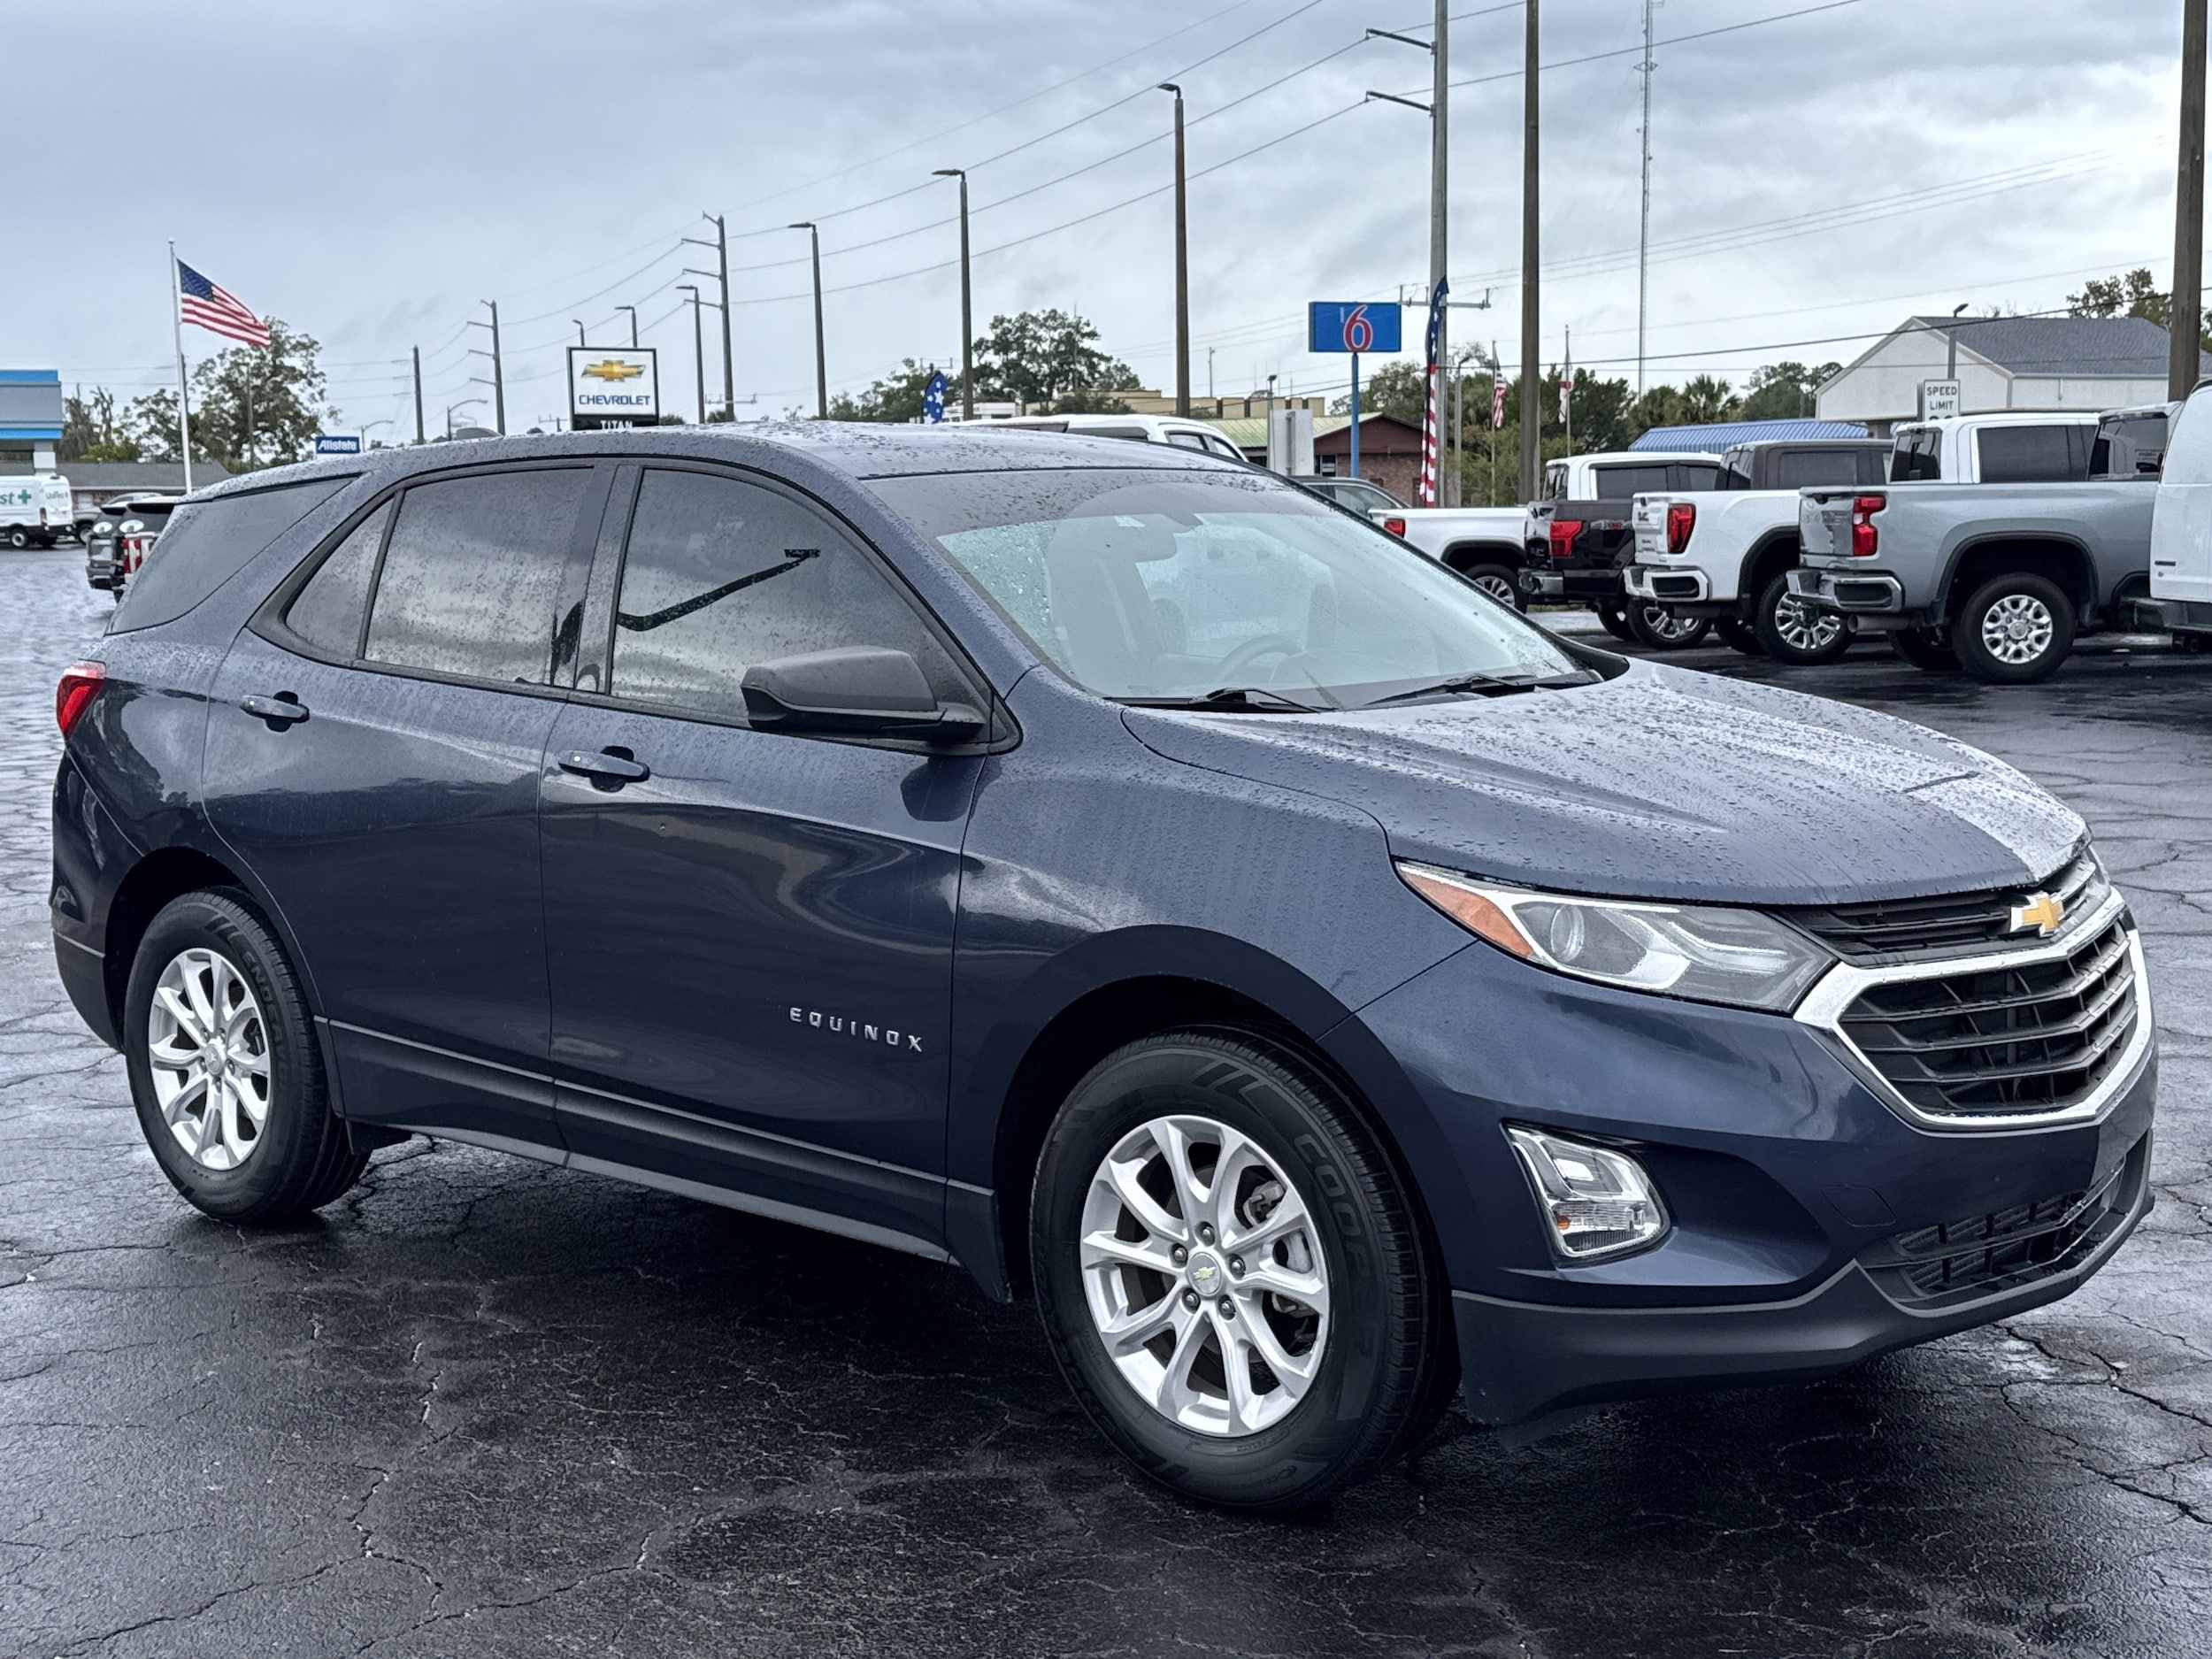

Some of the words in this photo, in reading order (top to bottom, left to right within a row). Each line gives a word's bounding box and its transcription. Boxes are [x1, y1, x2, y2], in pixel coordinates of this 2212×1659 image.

[1926, 386, 1957, 396] SPEED
[579, 395, 650, 405] CHEVROLET
[1929, 400, 1955, 411] LIMIT
[600, 420, 634, 430] TITAN
[318, 440, 357, 451] Allstate
[789, 1007, 923, 1053] EQUINOX
